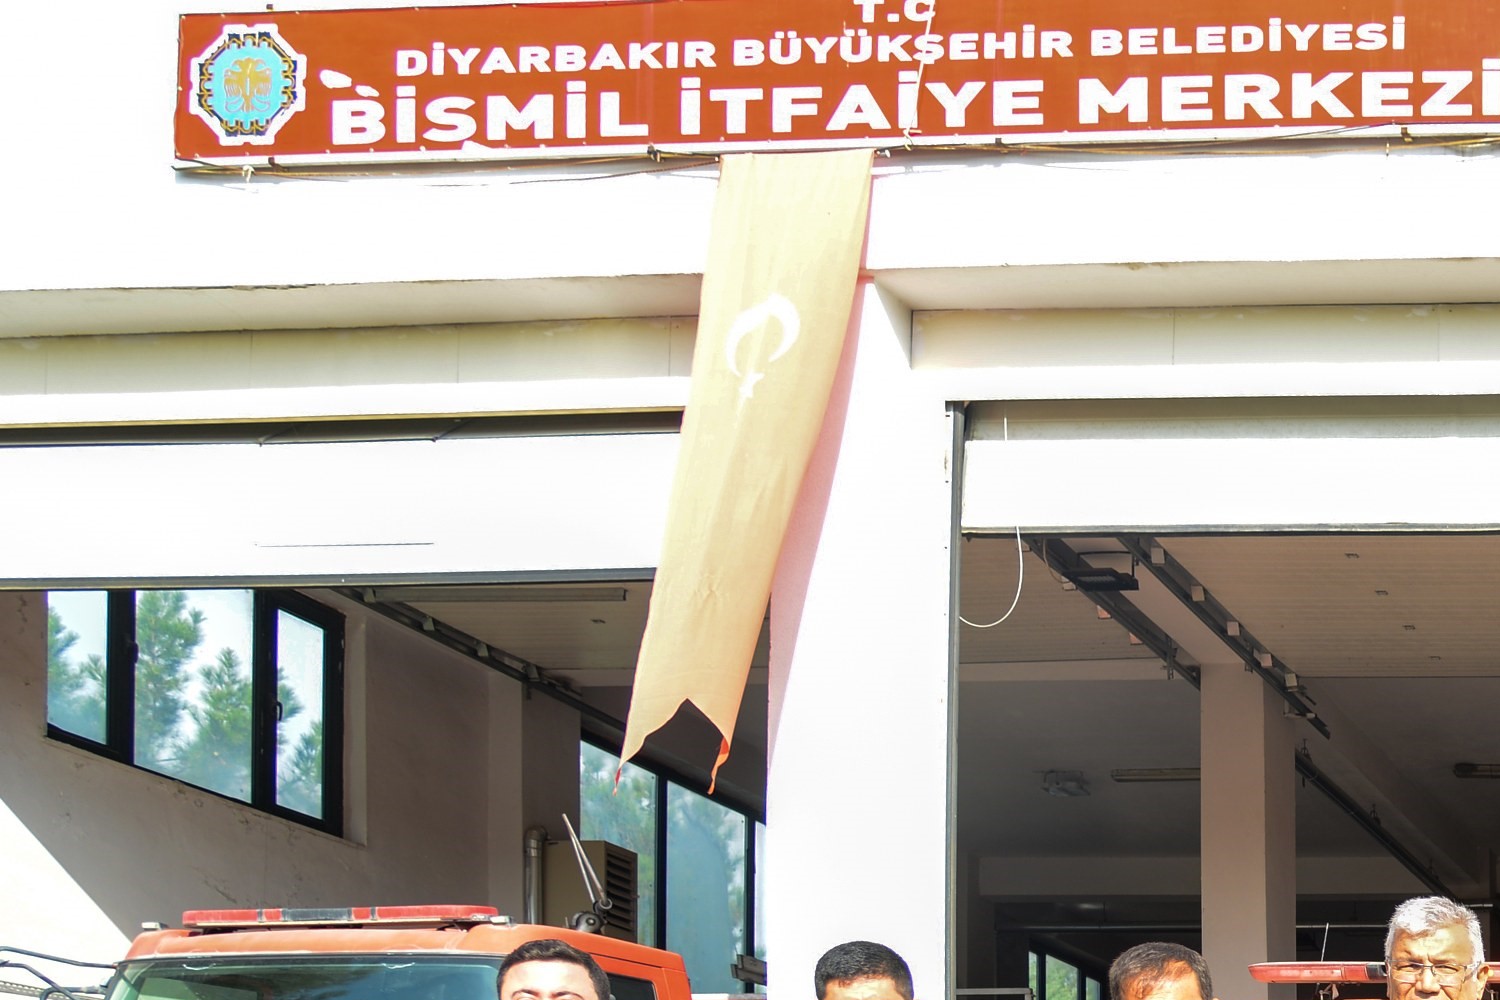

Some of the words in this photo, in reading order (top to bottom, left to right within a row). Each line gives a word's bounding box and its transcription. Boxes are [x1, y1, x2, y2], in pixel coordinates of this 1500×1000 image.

[396, 42, 716, 77] DİYARBAKIR
[732, 24, 1074, 67] BÜYÜKŞEHİR
[1090, 15, 1406, 57] BELEDİYESİ
[331, 80, 650, 146] BİSMİL
[680, 70, 1045, 135] İTFAİYE
